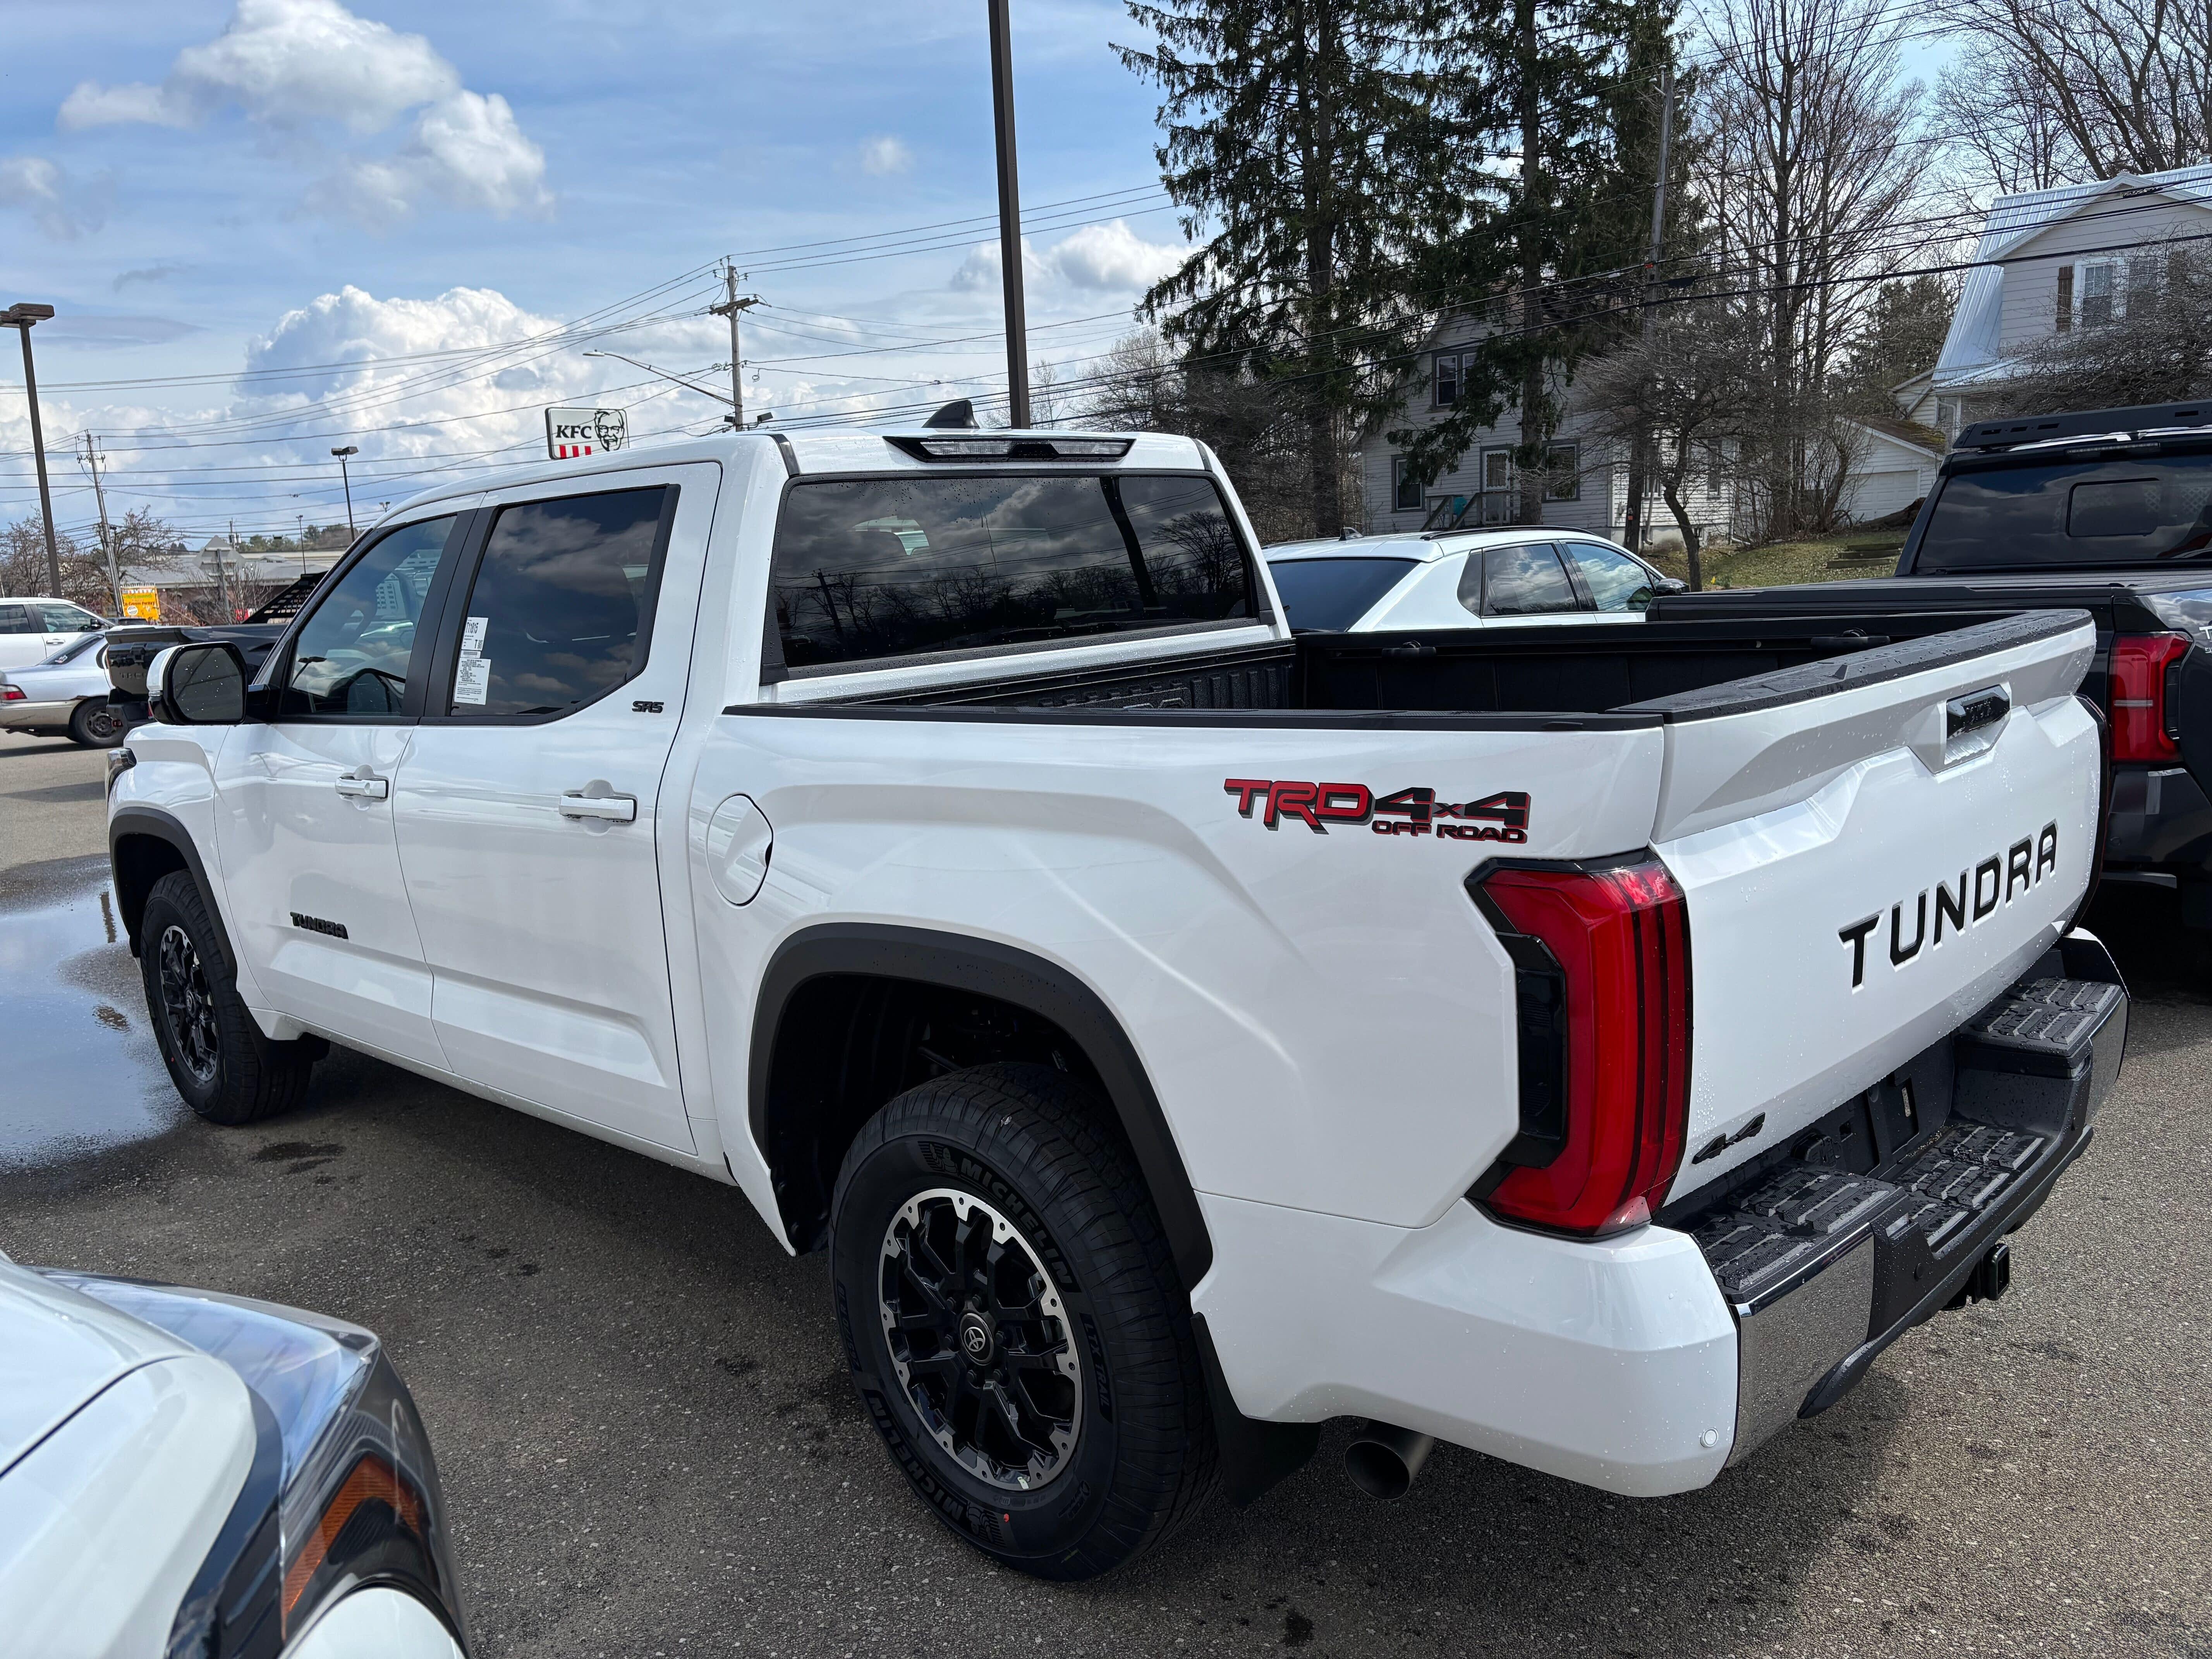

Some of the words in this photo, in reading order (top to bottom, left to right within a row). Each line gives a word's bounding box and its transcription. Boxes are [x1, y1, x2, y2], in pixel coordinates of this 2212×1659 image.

[555, 425, 592, 439] KFC
[1224, 778, 1374, 835] TRD
[1372, 820, 1432, 836] OFF
[1436, 823, 1528, 844] ROAD
[290, 911, 349, 939] TUNDRA
[1838, 819, 2058, 993] TUNDRA
[960, 1158, 1073, 1284] MICHELIN
[1084, 1322, 1101, 1357] LTX
[1096, 1364, 1109, 1407] TRAIL
[868, 1397, 963, 1521] MICHELIN
